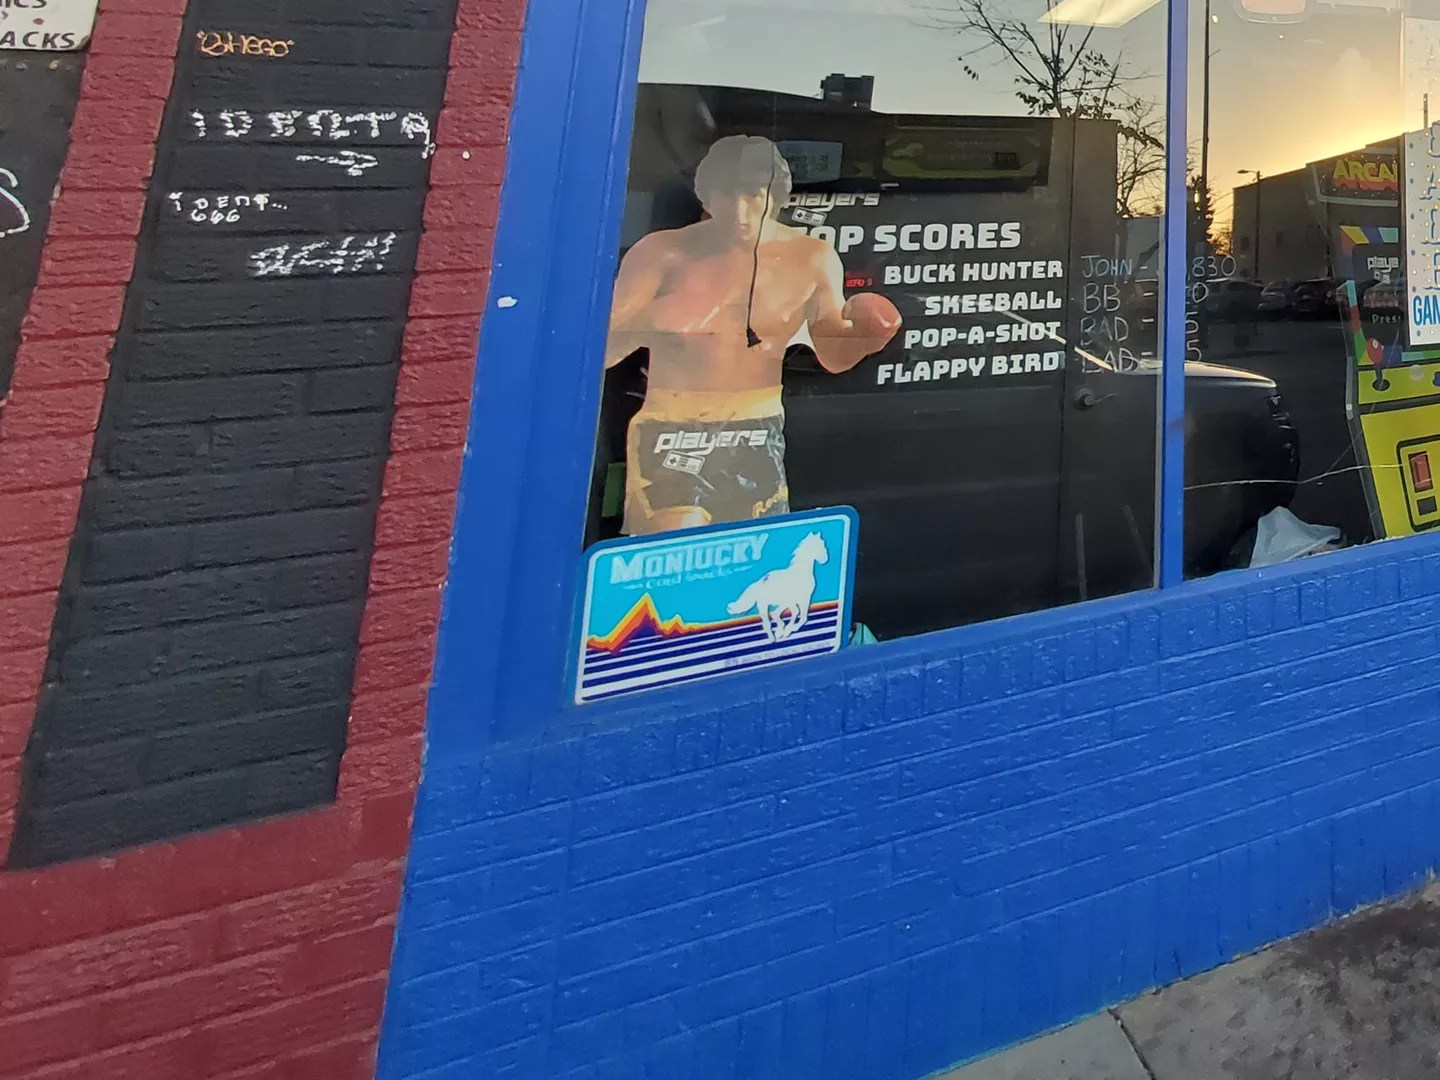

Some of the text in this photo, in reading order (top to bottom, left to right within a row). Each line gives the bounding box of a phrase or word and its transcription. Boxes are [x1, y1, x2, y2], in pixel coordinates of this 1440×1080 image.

[1332, 159, 1400, 190] ARCA
[789, 222, 1022, 253] OP SCORES
[883, 260, 1064, 286] BUCK HUNTER
[1080, 254, 1133, 278] JOHN
[924, 290, 1062, 316] SKEEBALL
[904, 321, 1061, 350] POP-A-SHOT
[877, 351, 1061, 385] FLAPPY BIRD
[654, 430, 768, 456] players
[610, 532, 769, 584] MONTUCKY
